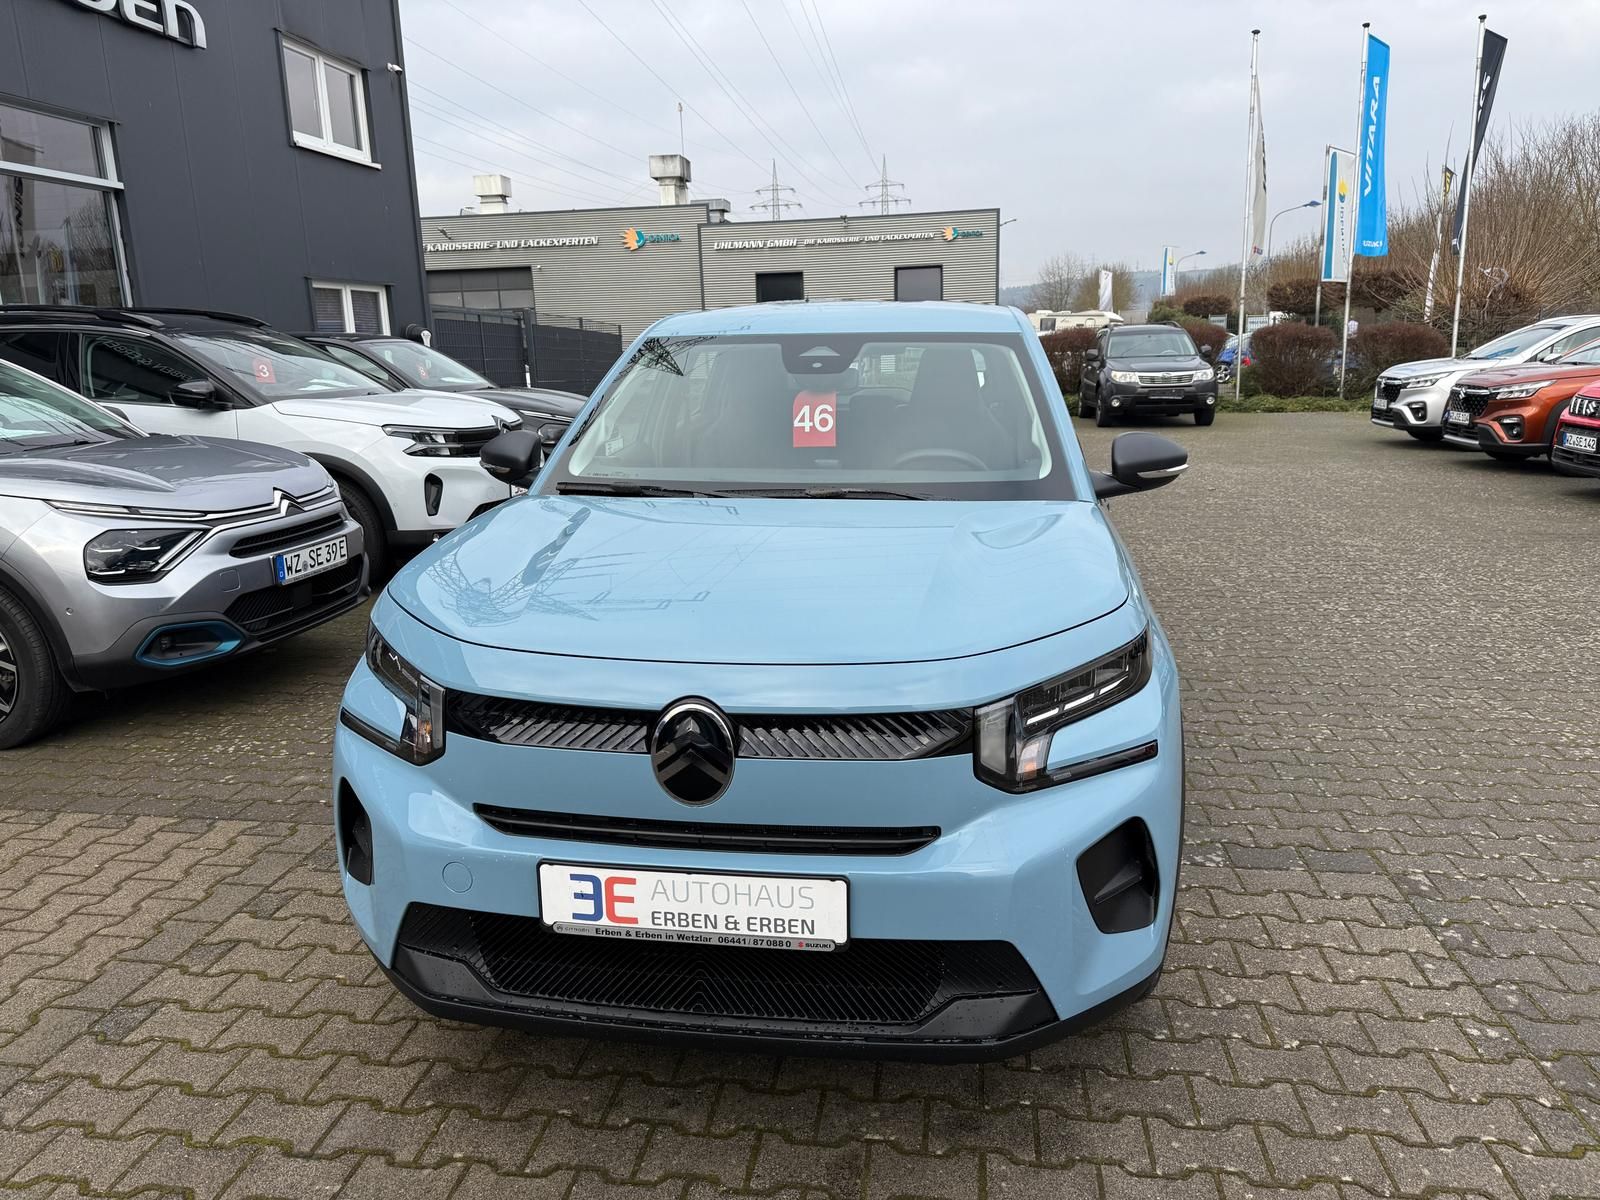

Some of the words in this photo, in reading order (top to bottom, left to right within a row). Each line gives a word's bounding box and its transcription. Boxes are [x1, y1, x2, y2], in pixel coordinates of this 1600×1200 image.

[1364, 76, 1380, 197] VITARA
[426, 241, 494, 252] KAROSSERIE-
[496, 239, 518, 249] UND
[521, 236, 599, 248] LACKEXPERTEN
[713, 240, 764, 250] UHLMANN
[766, 238, 797, 248] GMBH
[881, 232, 935, 241] LACKEXPERTEN
[259, 364, 270, 378] 3
[793, 403, 834, 433] 46
[285, 554, 302, 576] WZ
[308, 547, 324, 568] SE
[651, 879, 815, 910] AUTOHAUS
[595, 927, 622, 937] Erben
[625, 930, 633, 938] &
[635, 930, 663, 940] Erben
[665, 932, 674, 940] in
[676, 933, 713, 943] Wetzlar
[651, 910, 718, 930] ERBEN
[724, 915, 741, 931] &
[747, 916, 815, 935] ERBEN
